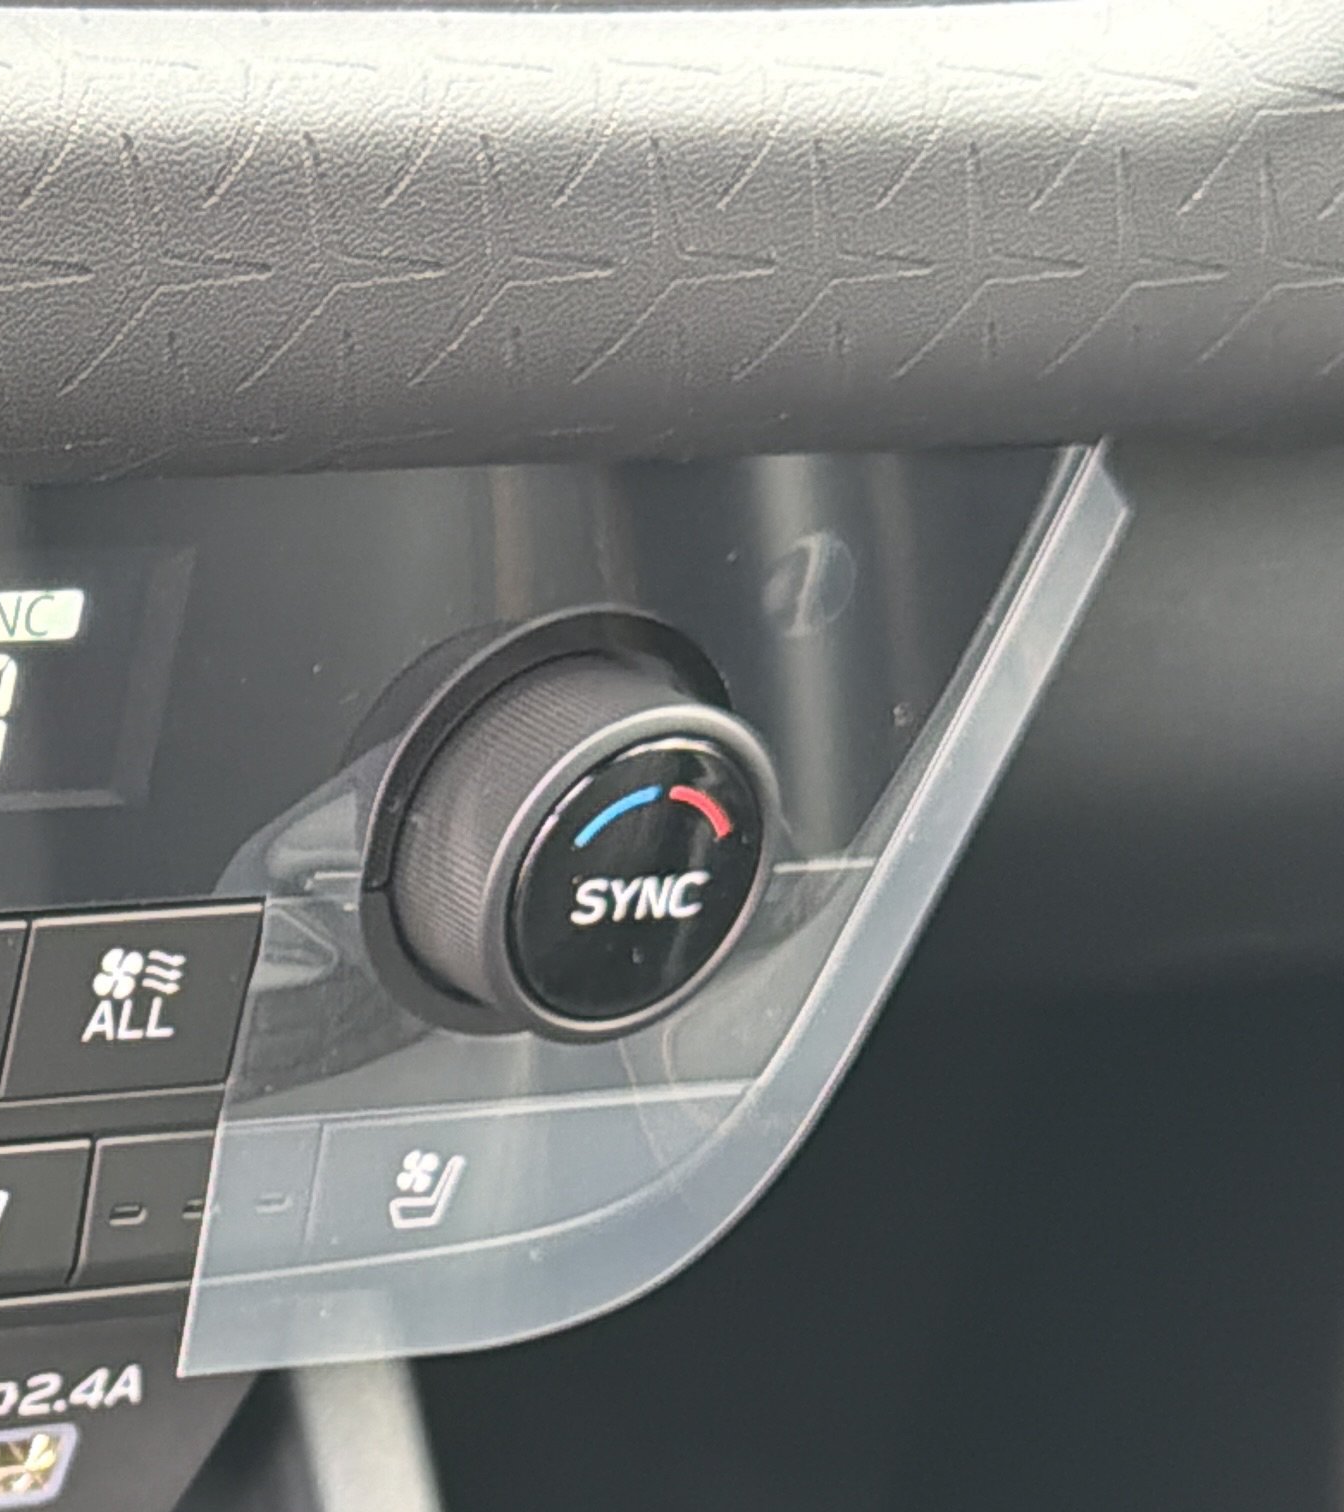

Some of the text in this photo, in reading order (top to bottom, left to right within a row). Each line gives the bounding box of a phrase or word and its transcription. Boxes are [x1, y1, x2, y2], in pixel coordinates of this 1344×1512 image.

[570, 869, 711, 926] SYNC
[81, 997, 174, 1043] ALL
[17, 1363, 143, 1418] 2.4A
